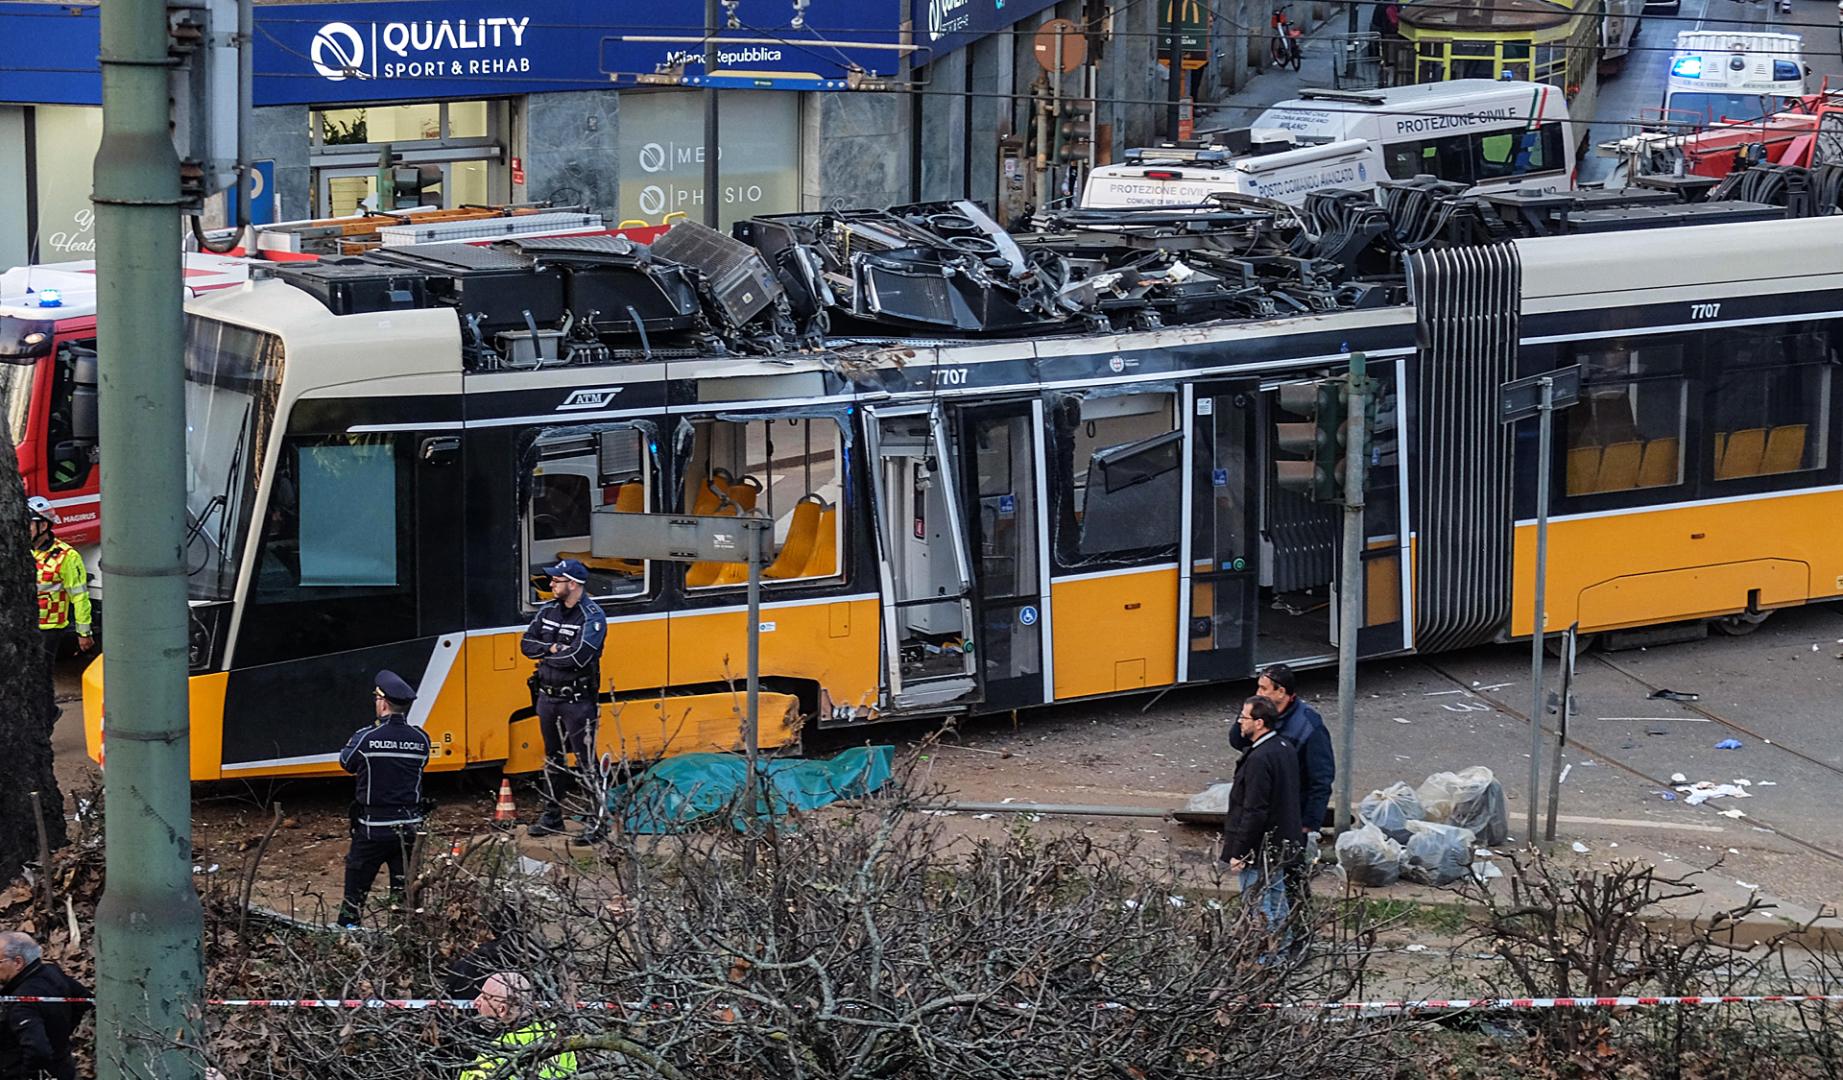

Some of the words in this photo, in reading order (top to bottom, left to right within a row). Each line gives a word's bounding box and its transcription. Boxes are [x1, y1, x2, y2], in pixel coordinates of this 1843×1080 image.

[383, 17, 530, 57] QUALITY
[384, 61, 445, 78] SPORT
[451, 61, 463, 75] &
[469, 58, 530, 74] REHAB
[1397, 113, 1476, 134] PROTEZIONE
[1478, 107, 1516, 124] CIVILE
[678, 146, 723, 163] ME
[1110, 184, 1177, 196] PROTEZIONE
[1180, 186, 1214, 196] CIVILE
[1258, 182, 1284, 198] POSTO
[1284, 174, 1319, 194] COMANDO
[1320, 168, 1354, 187] AVANZATO
[678, 185, 762, 206] PHSIO
[49, 232, 95, 252] Heal
[1691, 303, 1721, 319] 7707
[931, 368, 968, 385] 7707
[63, 512, 96, 523] MAGIRUS
[369, 740, 398, 749] POLIZIA
[399, 741, 425, 751] LOCALE
[444, 733, 452, 743] B
